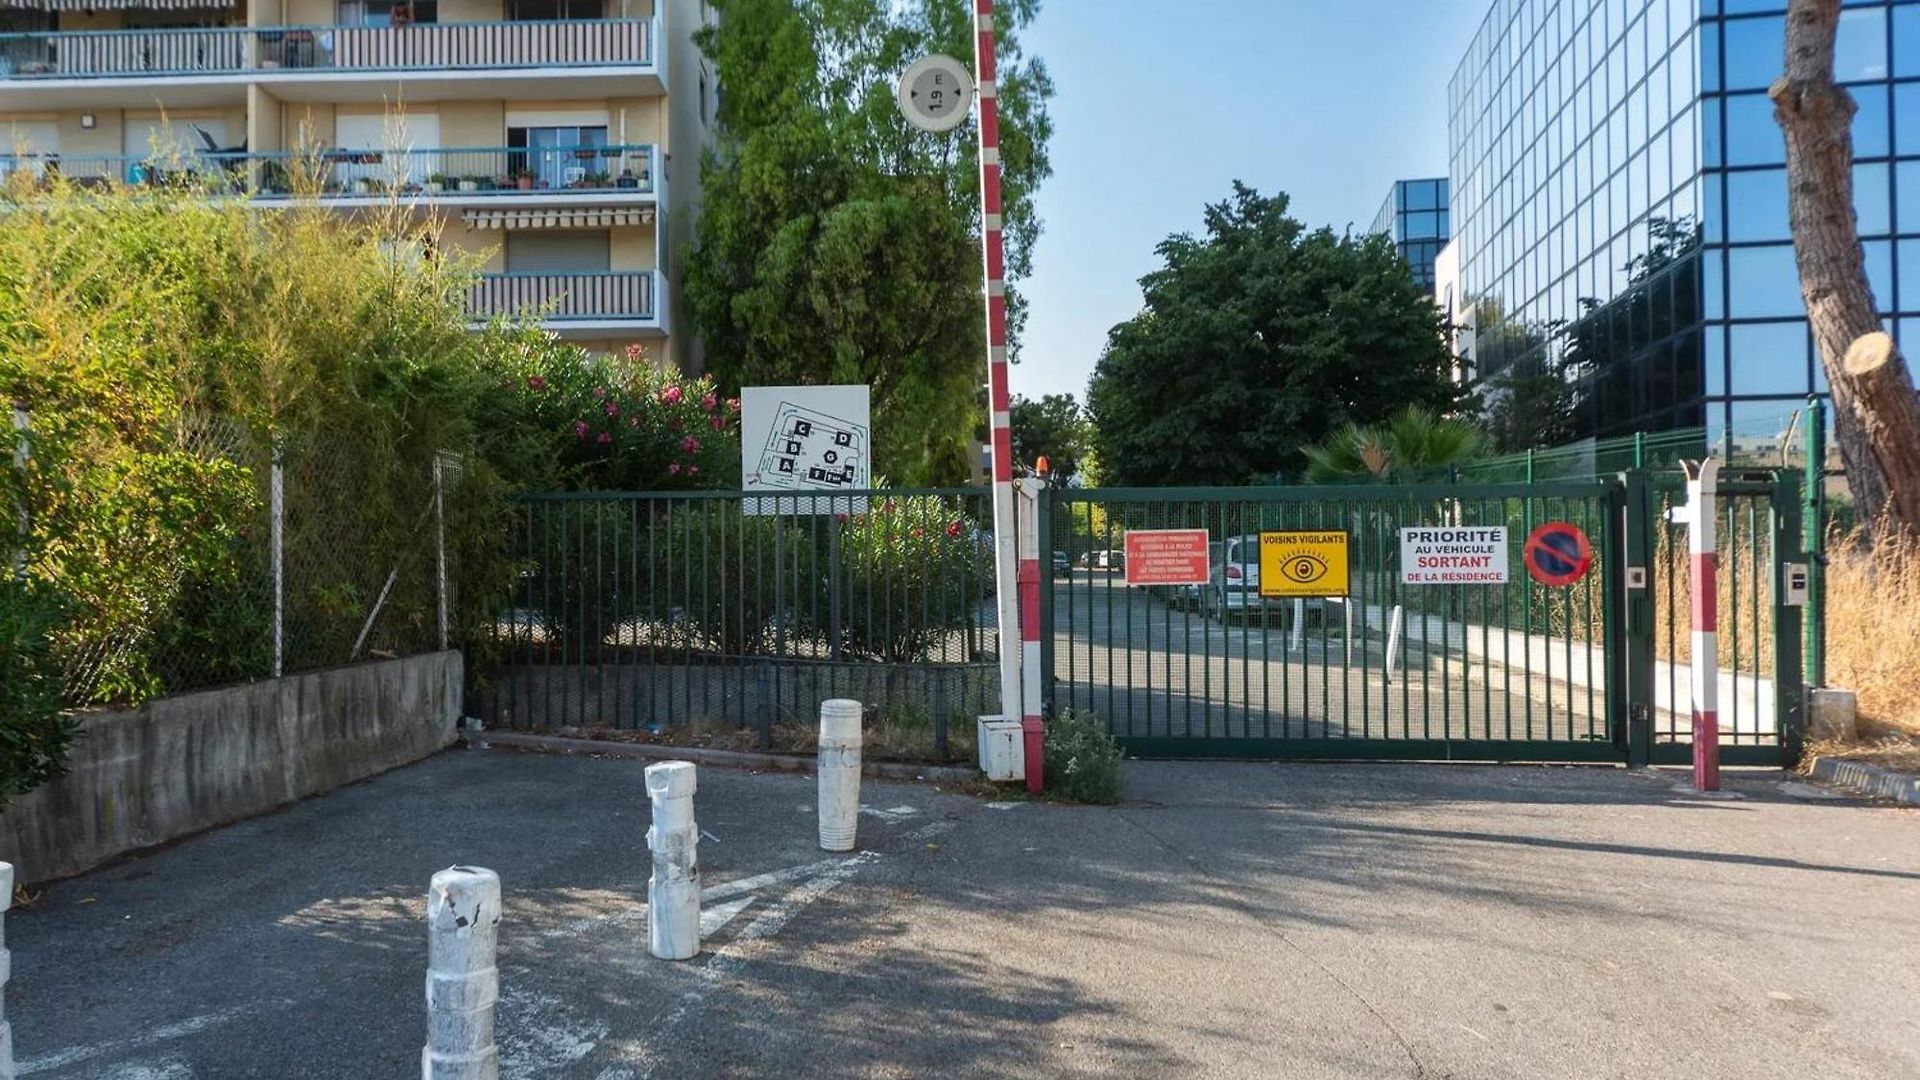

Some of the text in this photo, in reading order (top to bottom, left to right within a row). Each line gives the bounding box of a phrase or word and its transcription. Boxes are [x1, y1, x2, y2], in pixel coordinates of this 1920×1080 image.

[928, 74, 943, 111] 1.9 m
[1264, 534, 1345, 545] VOISINS VIGILANTS
[1407, 528, 1502, 543] PRIORITÉ
[1415, 546, 1432, 554] AU
[1418, 556, 1492, 568] SORTANT
[1407, 572, 1421, 581] DE
[1425, 572, 1438, 581] LA
